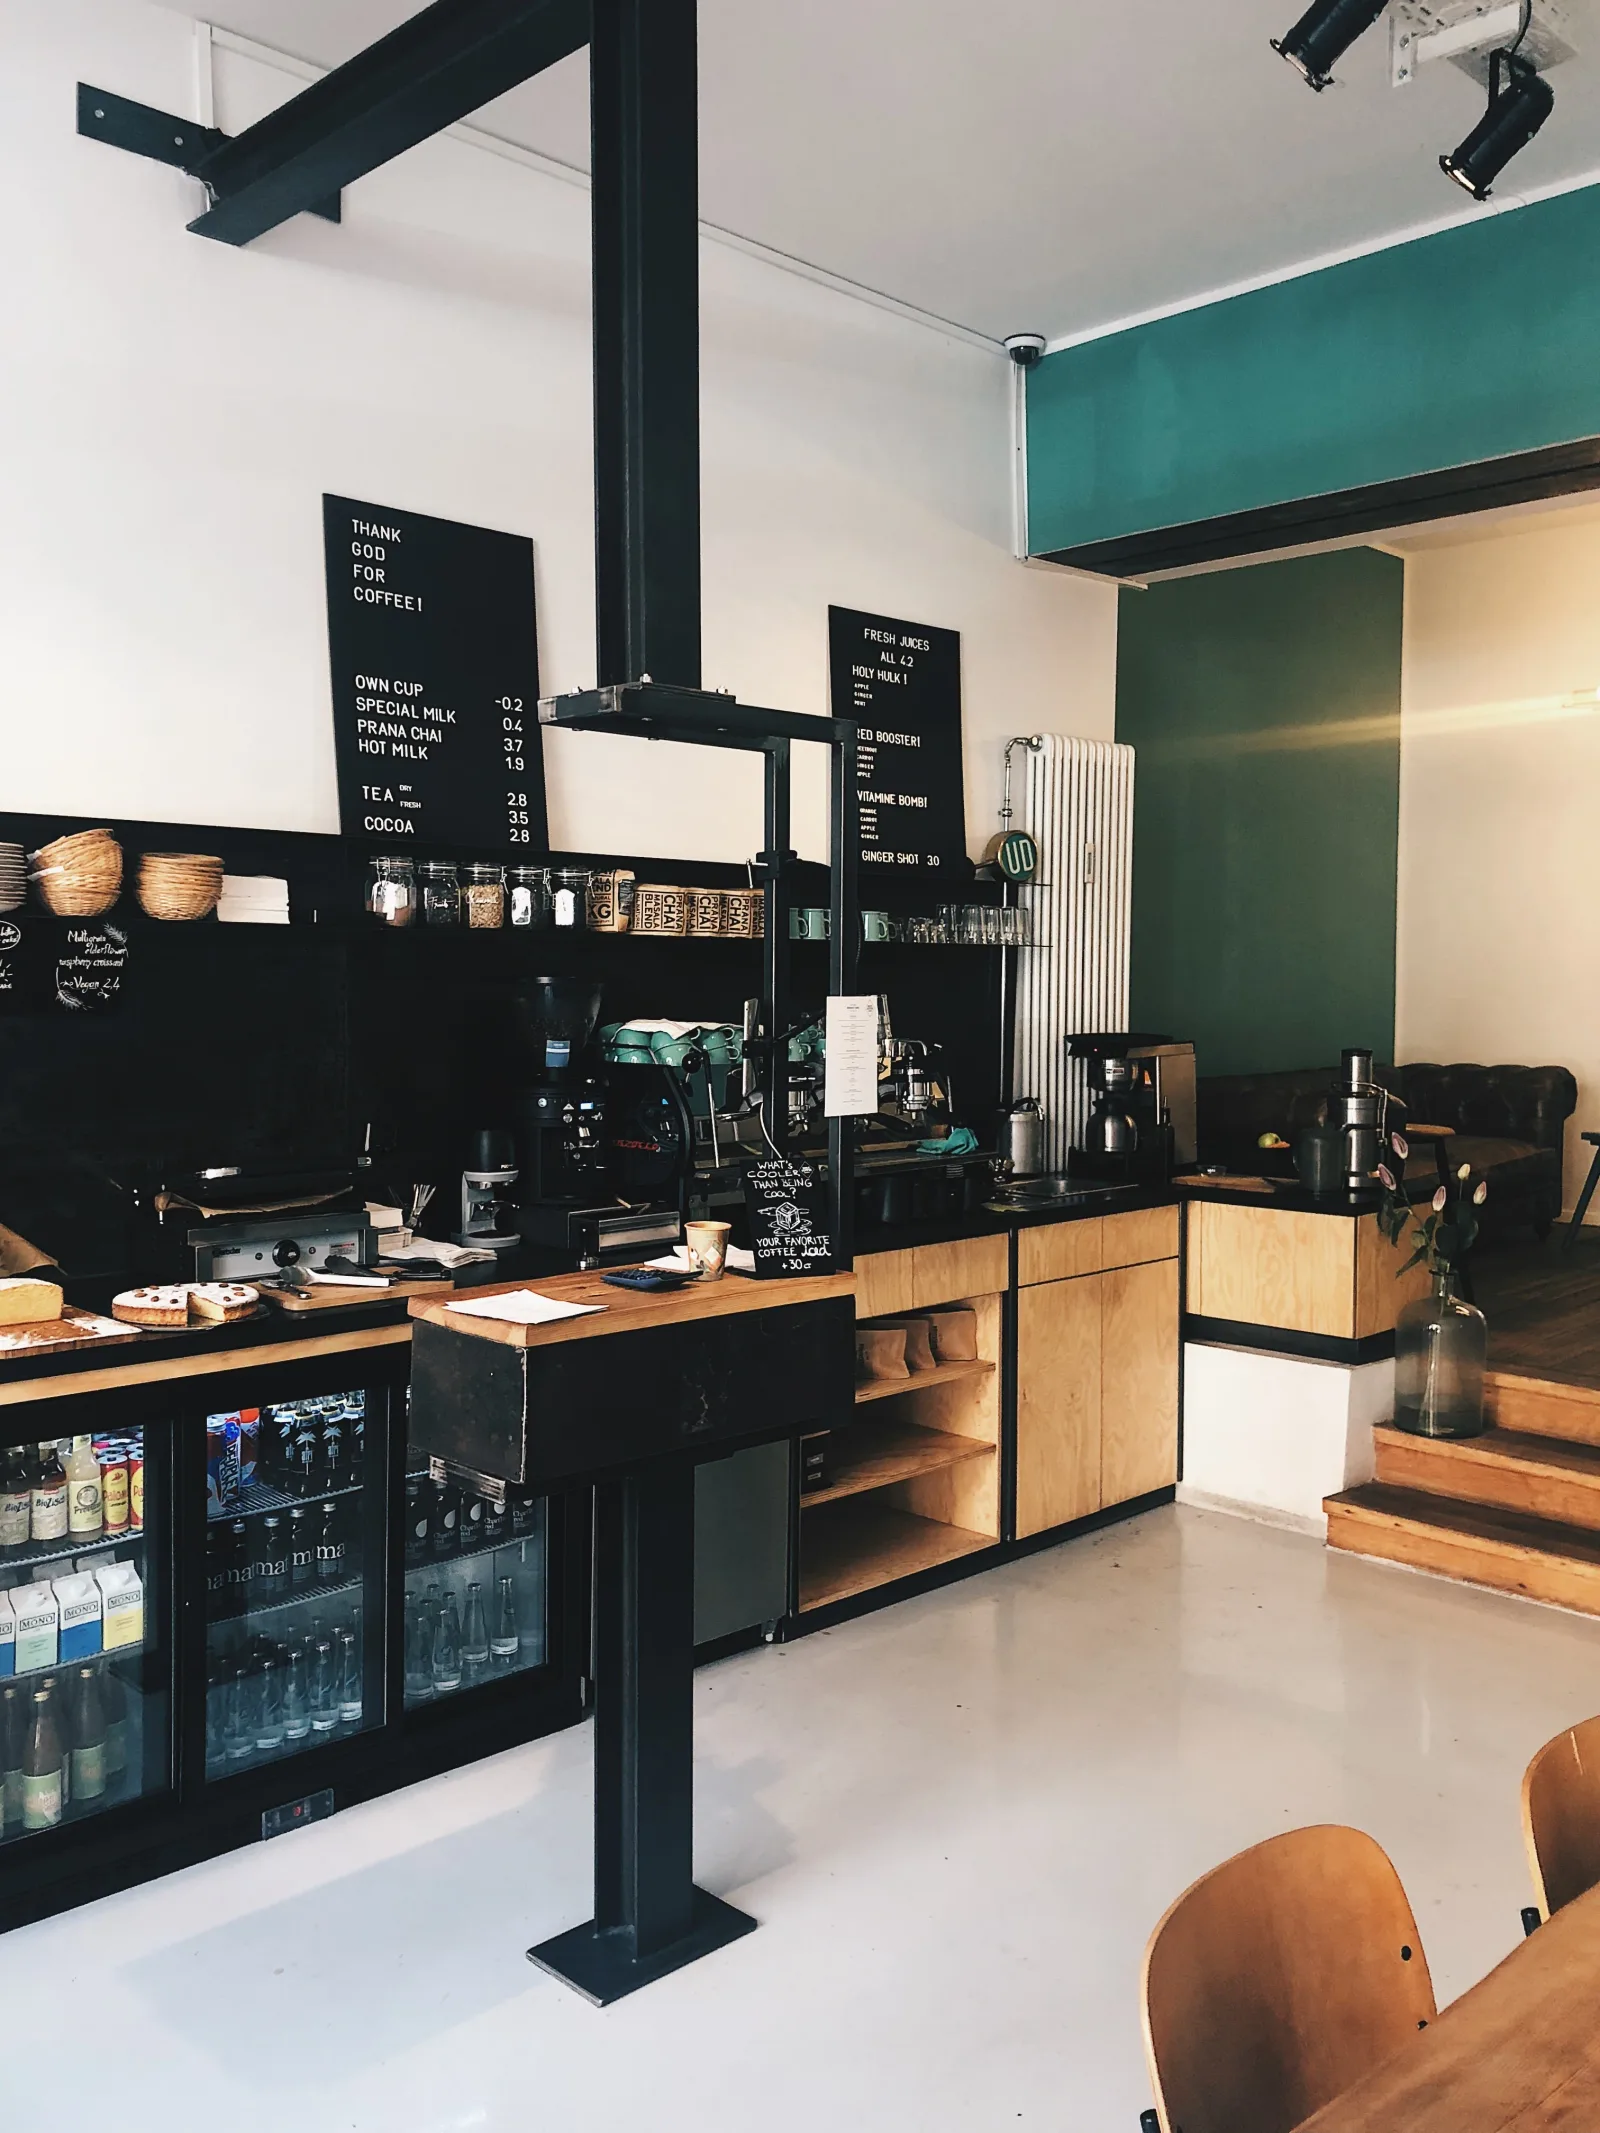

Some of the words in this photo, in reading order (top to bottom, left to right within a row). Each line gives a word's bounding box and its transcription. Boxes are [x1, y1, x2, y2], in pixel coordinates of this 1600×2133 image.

[351, 519, 401, 543] THANK
[351, 541, 385, 561] GOD
[353, 563, 385, 583] FOR
[864, 628, 896, 645] FRESH
[899, 636, 930, 651] JUICES
[880, 651, 896, 664] ALL
[852, 664, 875, 679] HOLY
[355, 674, 389, 693] OWN
[393, 680, 423, 697] CUP
[494, 696, 523, 712] -0.2
[355, 697, 419, 719] SPECIAL
[423, 706, 456, 724] MILK
[502, 717, 523, 732] 0.4
[357, 719, 407, 739] PRANA
[410, 726, 442, 743] CHAI
[503, 738, 523, 752] 3.7
[358, 739, 386, 755] HOT
[392, 743, 428, 760] MILK
[505, 757, 524, 771] 1.9
[362, 785, 394, 802] TEA
[399, 784, 412, 792] DRY
[507, 792, 527, 806] 2.8
[857, 789, 896, 805] VITAMINE
[508, 811, 529, 825] 3.5
[364, 816, 415, 834] COCOA
[509, 829, 530, 843] 2.8
[862, 850, 894, 863] GINGER
[897, 852, 919, 865] SHOT
[644, 893, 652, 929] BLEND
[664, 894, 676, 929] CHAI
[675, 895, 683, 930] PRANA
[699, 896, 711, 929] CHAI
[730, 897, 741, 931] CHAI
[741, 898, 749, 931] PRANA
[73, 976, 100, 993] Vegan
[747, 1169, 800, 1178] COOLER
[752, 1179, 778, 1189] THAN
[781, 1178, 812, 1188] BEING
[756, 1237, 781, 1247] YOUR
[784, 1235, 830, 1247] FAVORITE
[758, 1246, 797, 1258] COFFEE
[110, 1593, 139, 1606] MONO
[66, 1603, 97, 1618] MONO
[21, 1615, 53, 1629] MONO
